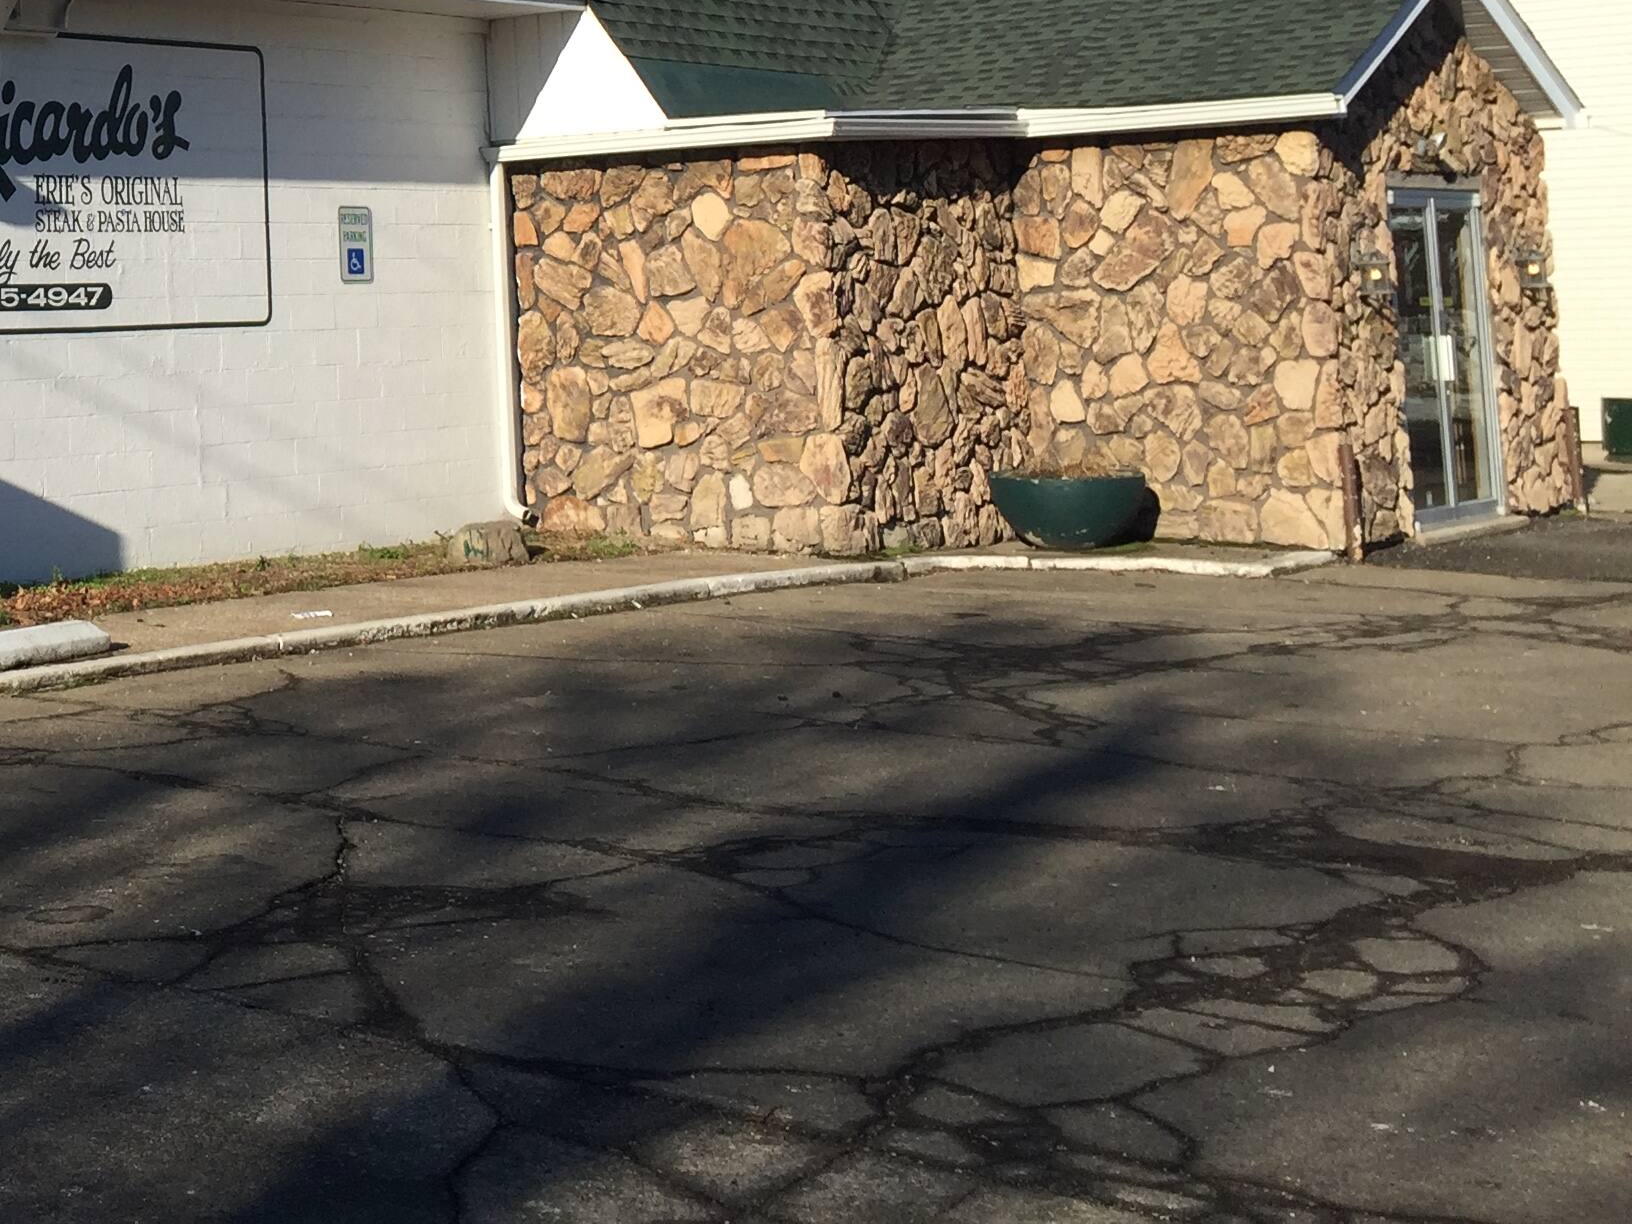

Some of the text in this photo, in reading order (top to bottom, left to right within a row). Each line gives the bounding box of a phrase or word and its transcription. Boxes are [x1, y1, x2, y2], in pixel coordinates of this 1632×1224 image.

[33, 173, 184, 207] ERIE'S ORIGINAL
[34, 208, 186, 234] STEAK & PASTA HOUSE
[28, 237, 61, 270] the
[68, 237, 118, 270] Best
